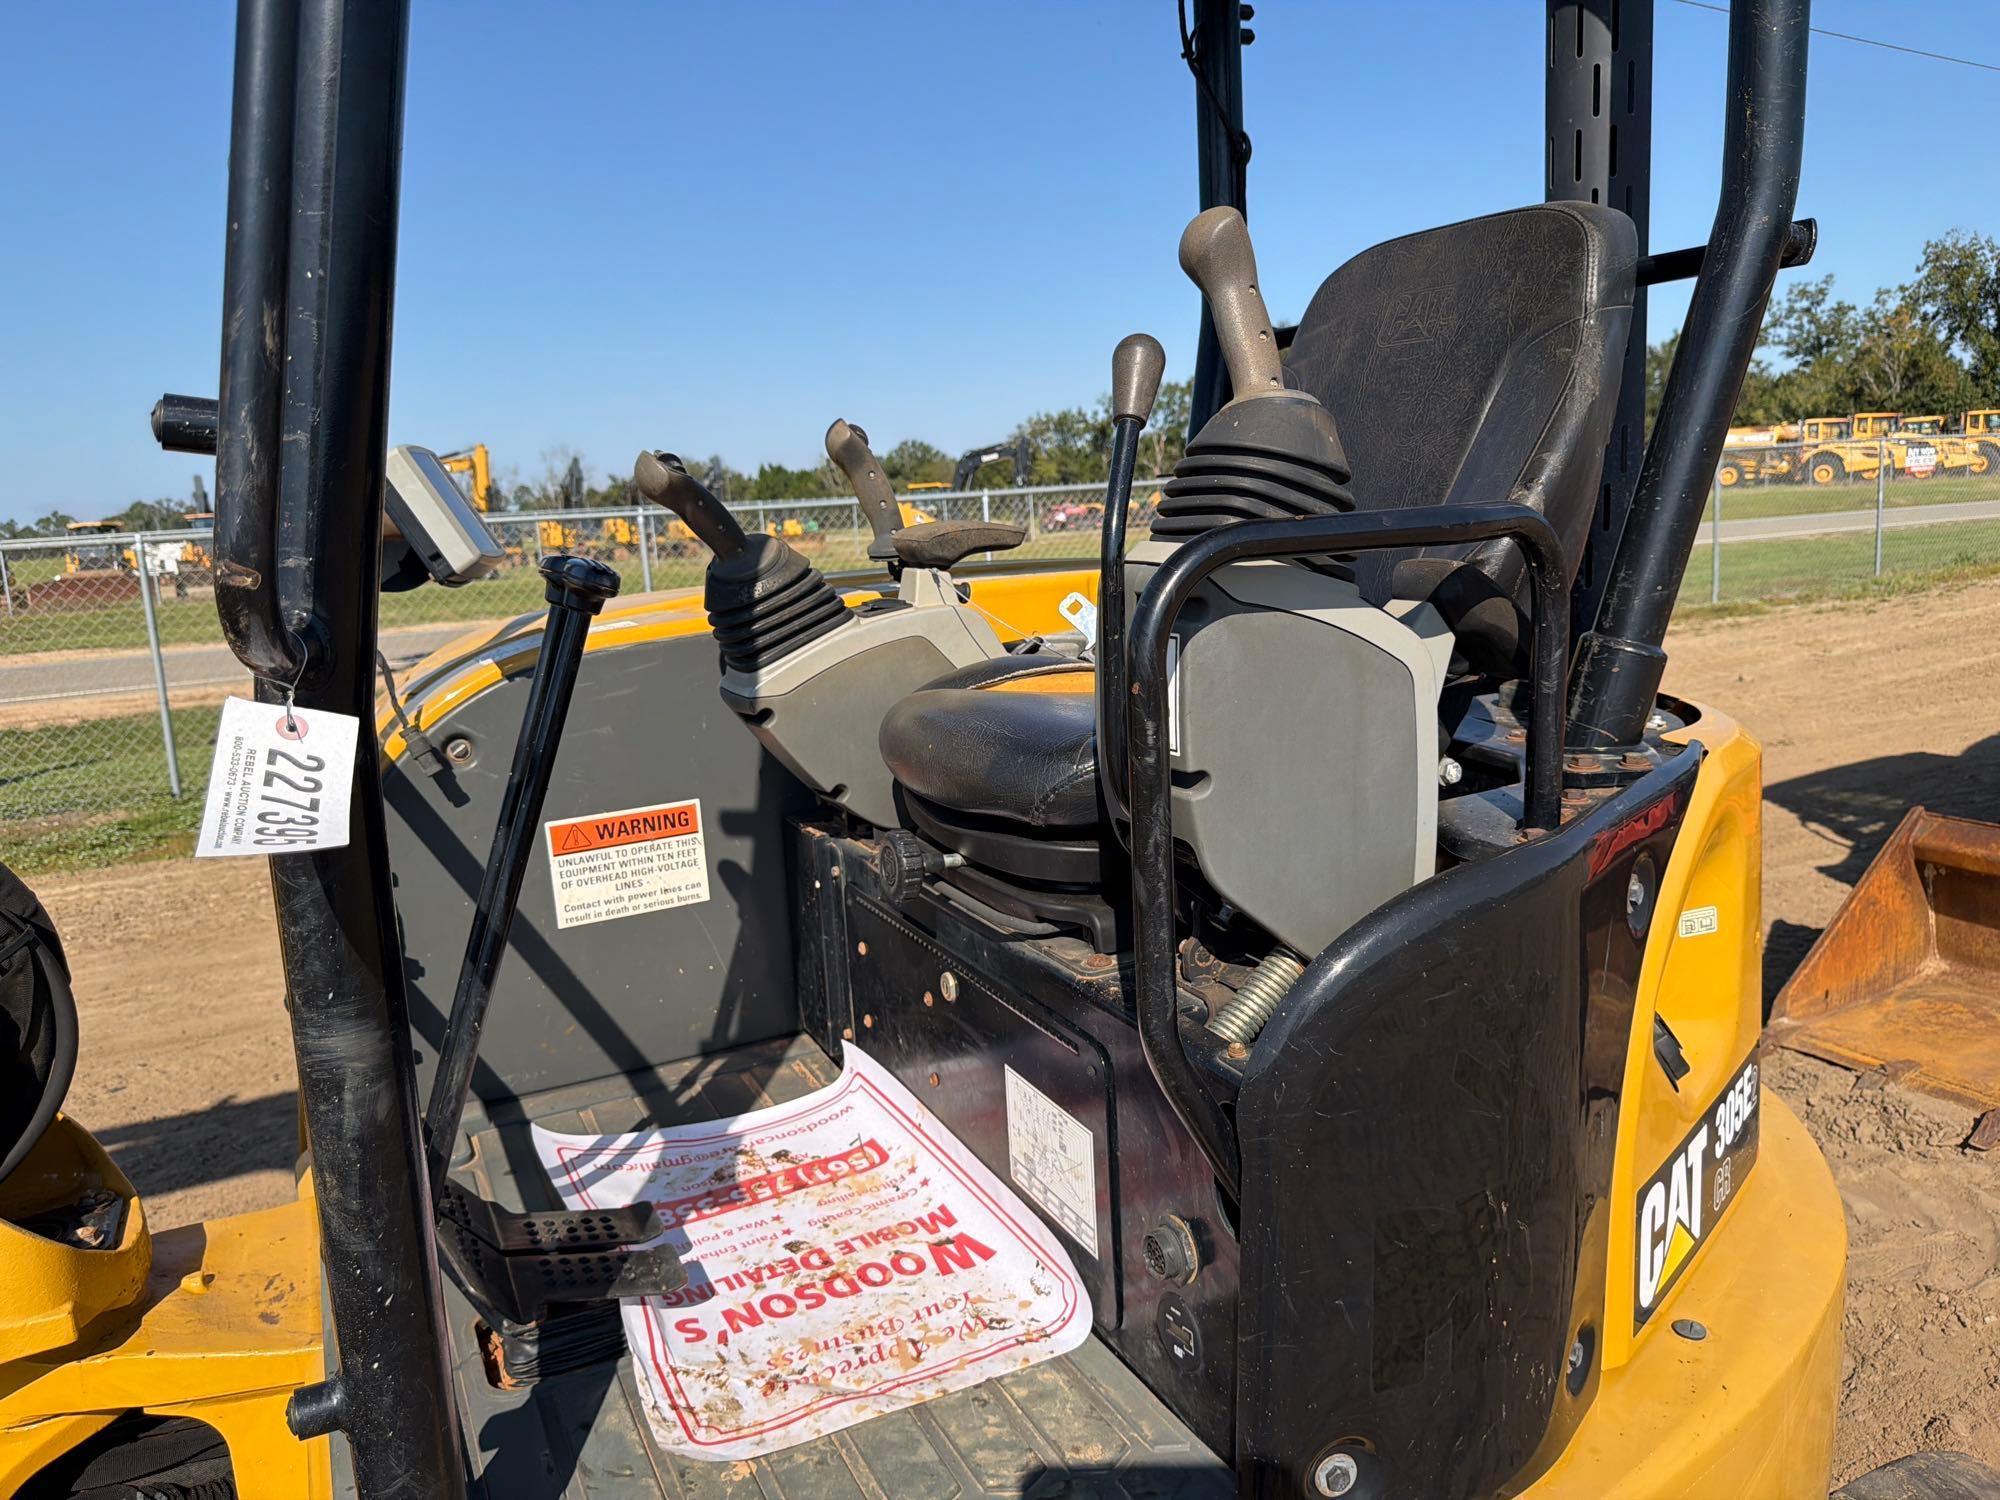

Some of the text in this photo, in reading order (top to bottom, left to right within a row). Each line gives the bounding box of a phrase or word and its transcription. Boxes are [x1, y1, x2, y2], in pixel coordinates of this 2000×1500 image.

[226, 735, 244, 786] 800-533-0673
[231, 748, 257, 845] REBEL AUCTION COMPANY
[253, 748, 325, 846] 227395
[595, 811, 690, 840] WARNING
[558, 837, 698, 868] UNLAWFUL TO OPERATE THIS
[559, 847, 698, 879] EQUIPMENT WITHIN TEN FEET
[561, 858, 699, 890] OF OVERHEAD HIGH-VOLTAGE
[615, 880, 644, 892] LINES
[564, 881, 702, 913] Contact with power lines can
[565, 909, 592, 924] result
[594, 910, 603, 918] in
[605, 905, 630, 917] death
[632, 902, 642, 912] or
[643, 898, 675, 910] serious
[656, 1146, 881, 1227] (561) 755-358
[816, 1186, 881, 1207] Detailing
[1713, 1156, 1731, 1212] CR
[807, 1187, 918, 1227] Ceramic Coating
[1639, 1124, 1708, 1309] CAT
[722, 1228, 734, 1237] &
[736, 1218, 769, 1233] Wax
[739, 1231, 780, 1249] Paint
[661, 1203, 959, 1306] MOBILE DETAILING
[674, 1232, 997, 1345] WOODSON'S
[766, 1292, 975, 1371] Your Business
[942, 1313, 992, 1341] We
